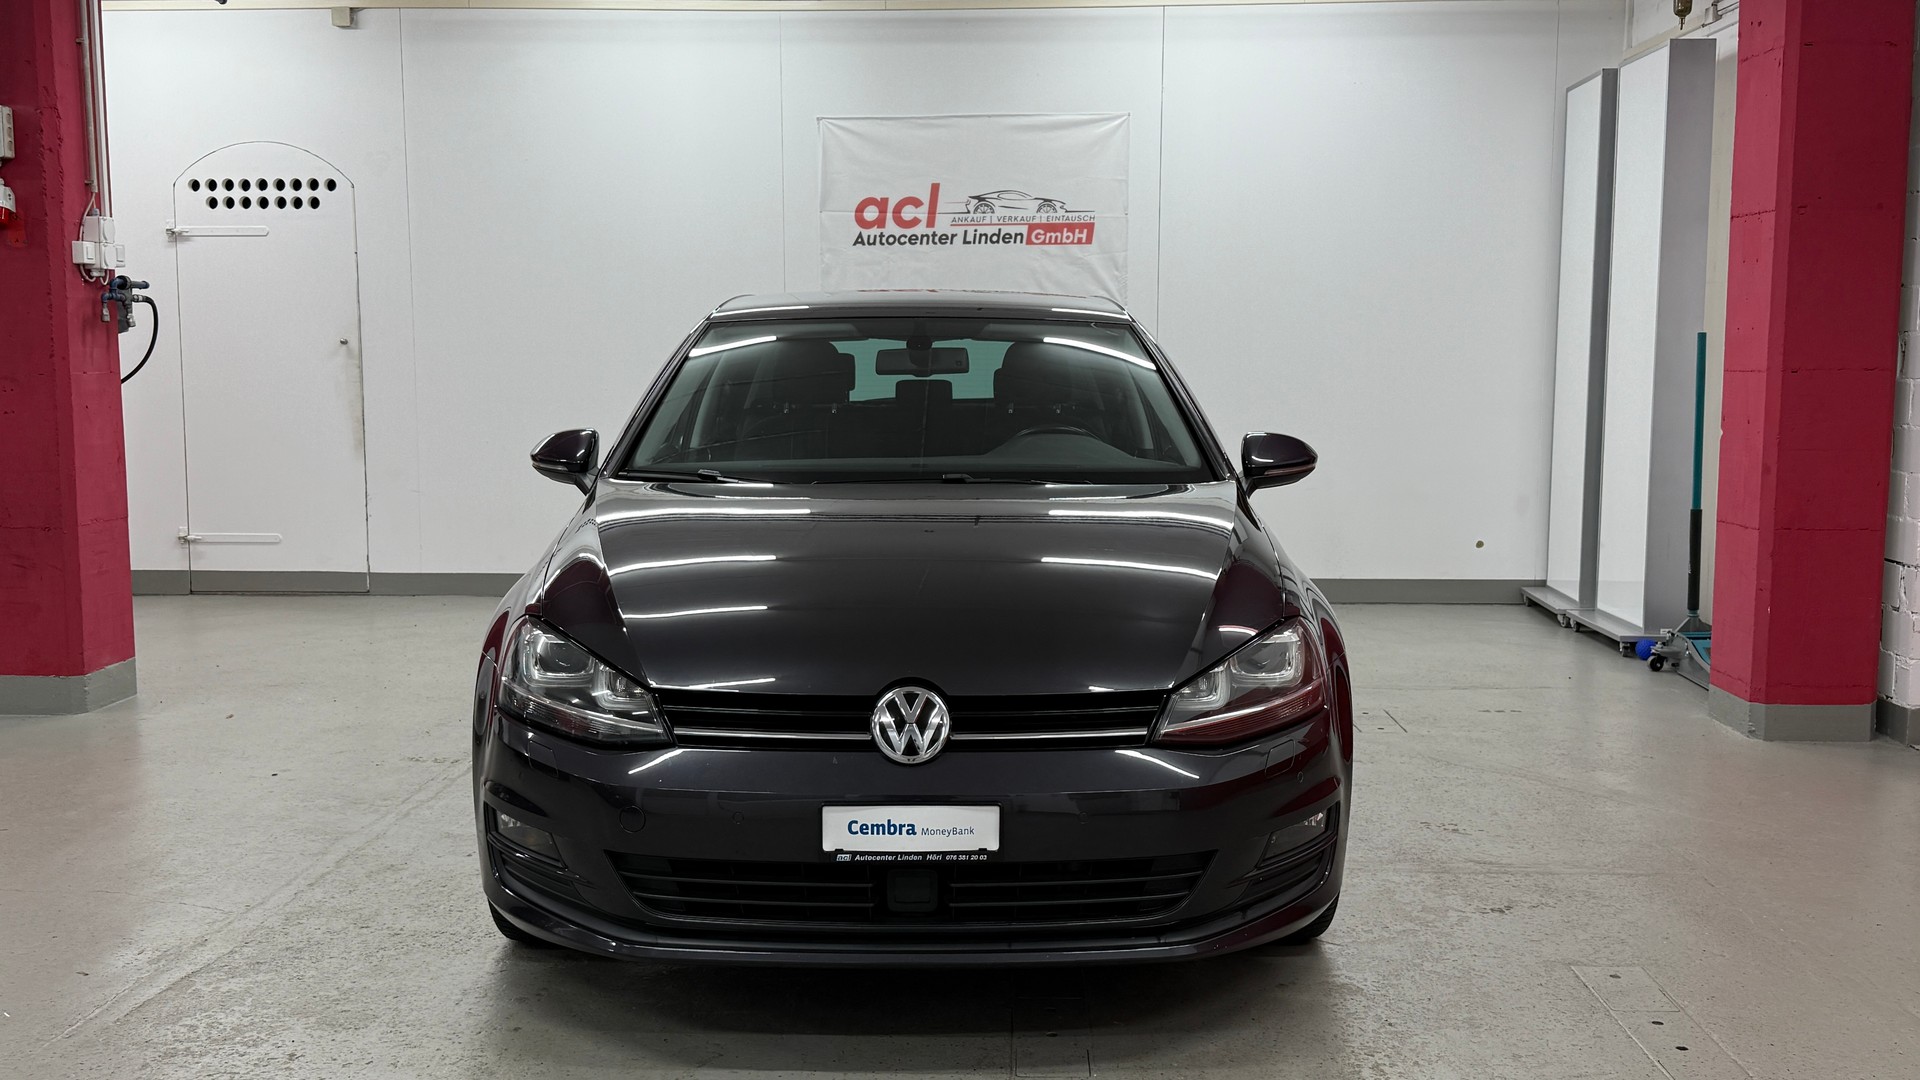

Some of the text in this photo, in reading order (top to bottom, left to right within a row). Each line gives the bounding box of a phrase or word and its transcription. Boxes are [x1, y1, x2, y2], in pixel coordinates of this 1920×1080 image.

[854, 183, 940, 230] acl
[951, 215, 987, 223] ANKAUF
[997, 215, 1037, 223] VERKAUF
[1046, 214, 1096, 222] EINTAUSCH
[852, 228, 1088, 247] Autocenter Linden GmbH
[847, 819, 975, 838] Cembra MoneyBank
[897, 853, 923, 861] Linden
